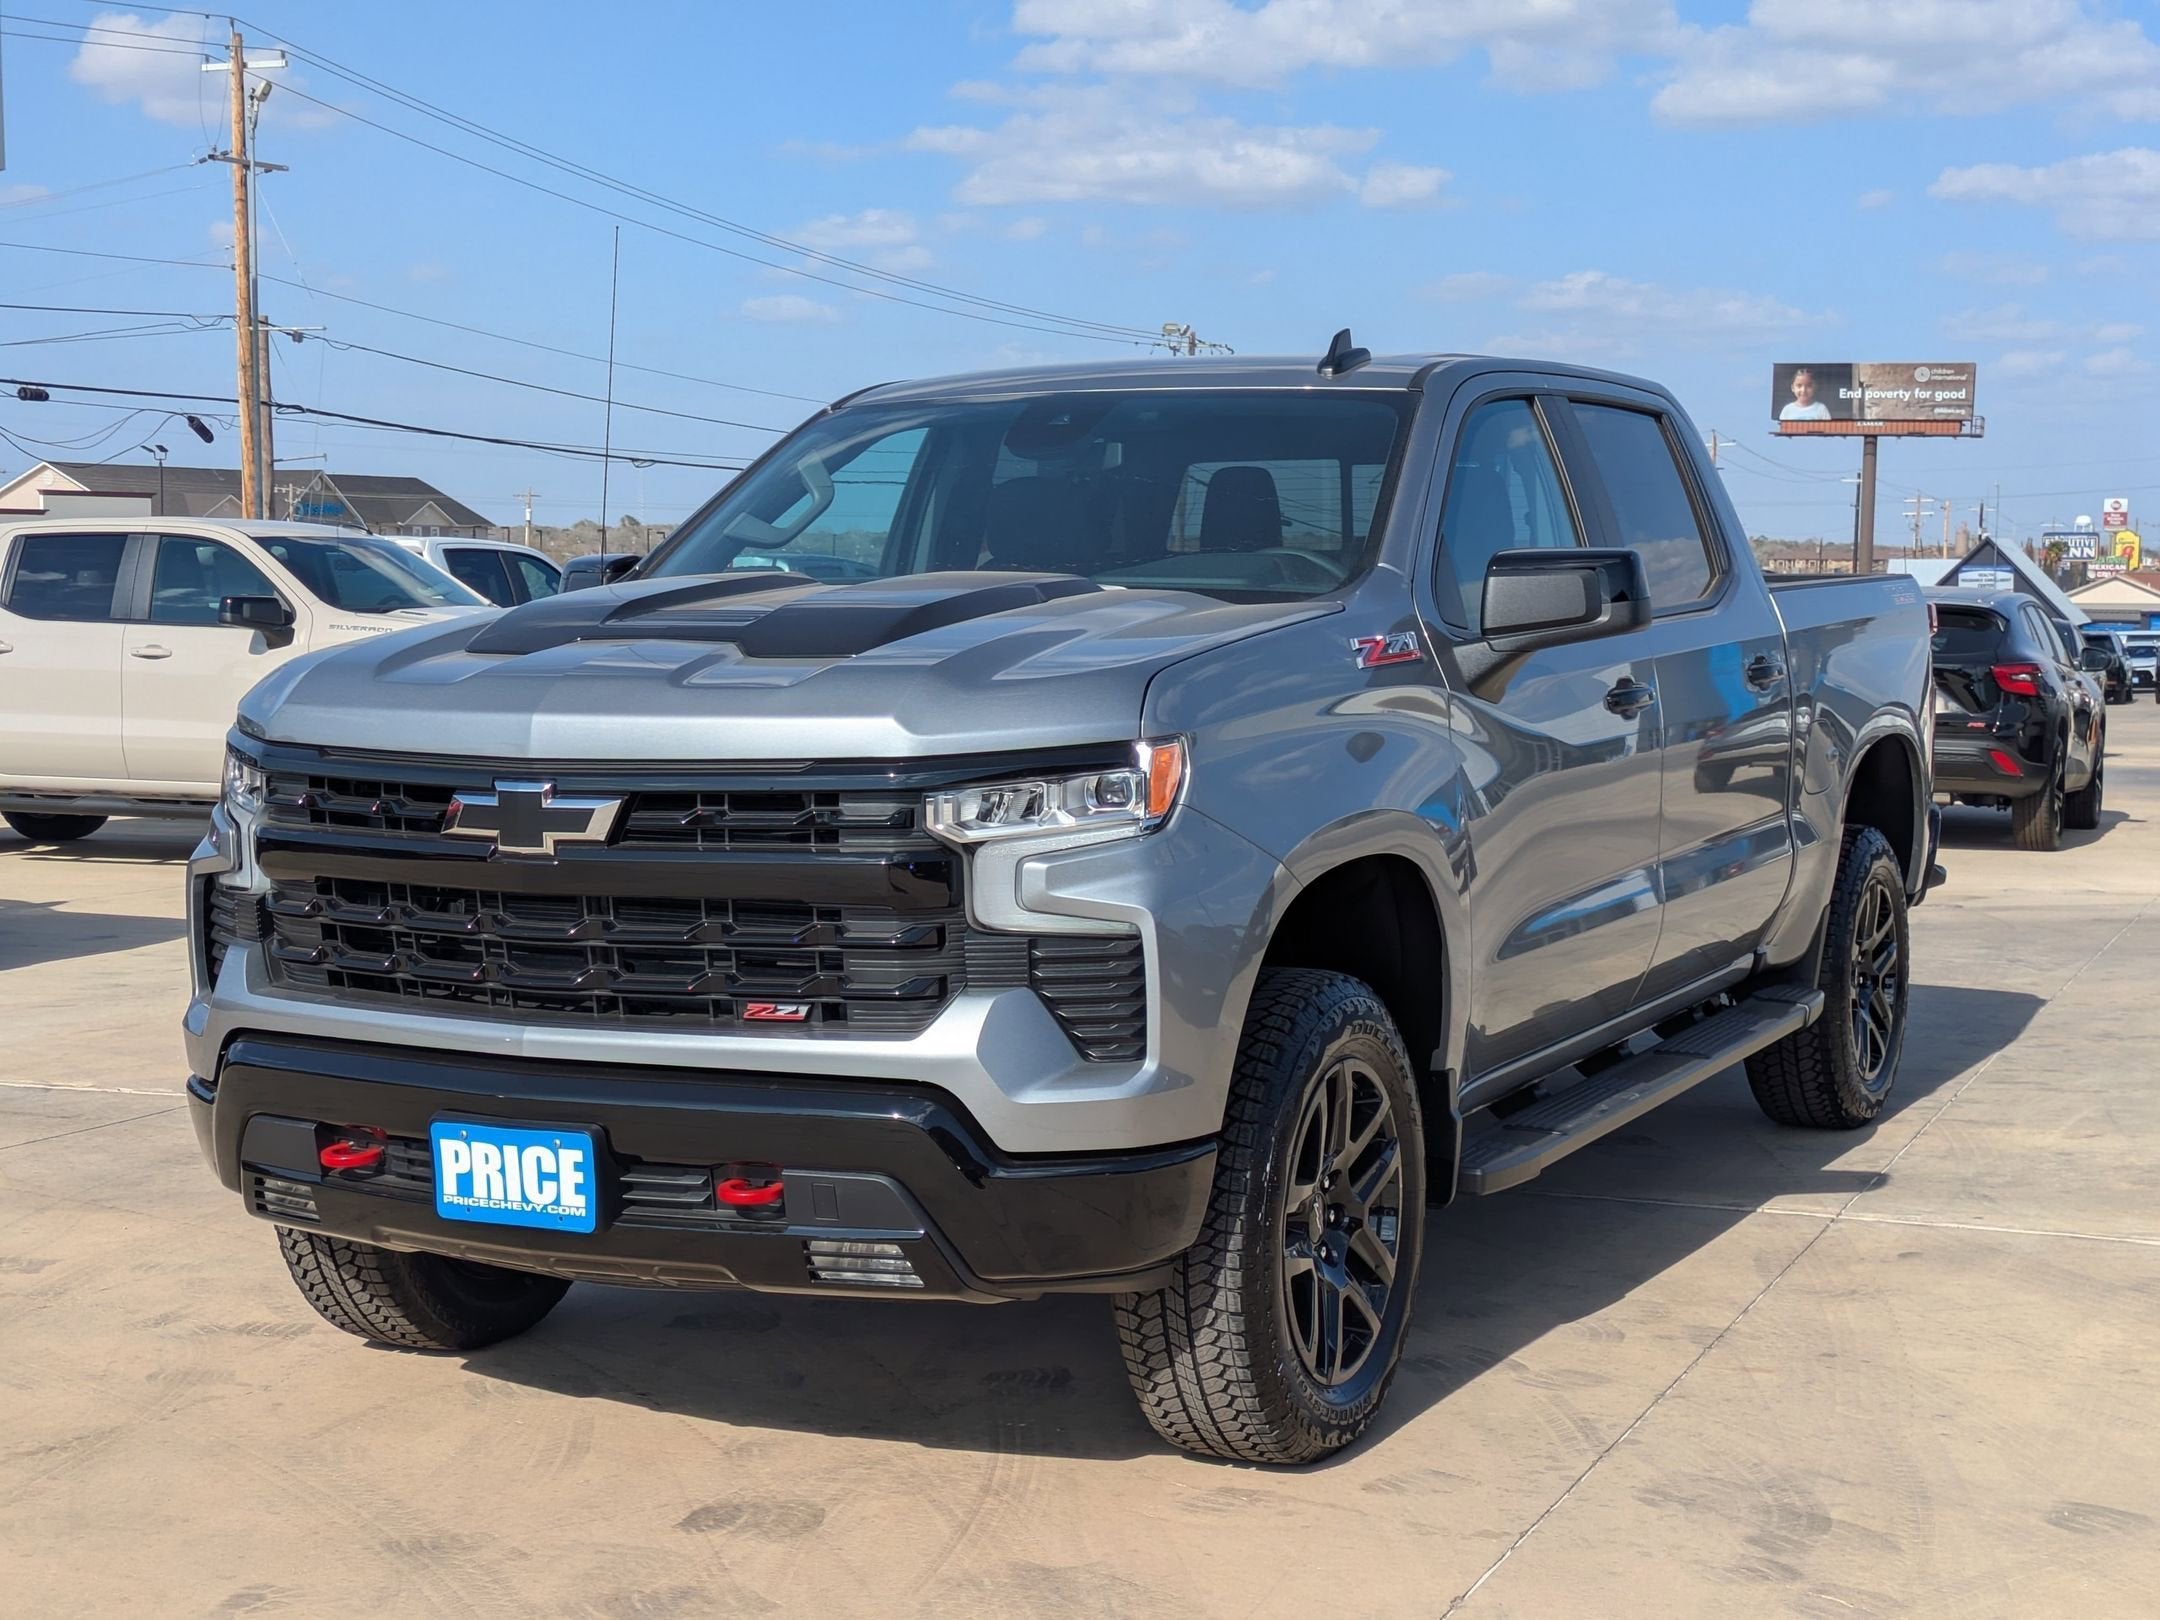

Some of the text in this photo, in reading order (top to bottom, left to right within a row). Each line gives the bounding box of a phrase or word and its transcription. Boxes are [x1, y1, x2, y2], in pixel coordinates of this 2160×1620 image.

[1839, 387, 1966, 402] End poverty for good
[2045, 538, 2096, 547] EUTIVE
[1349, 631, 1420, 669] Z71
[743, 1003, 811, 1020] Z71
[439, 1138, 586, 1208] PRICE
[443, 1194, 586, 1217] PRICECHEVY.COM
